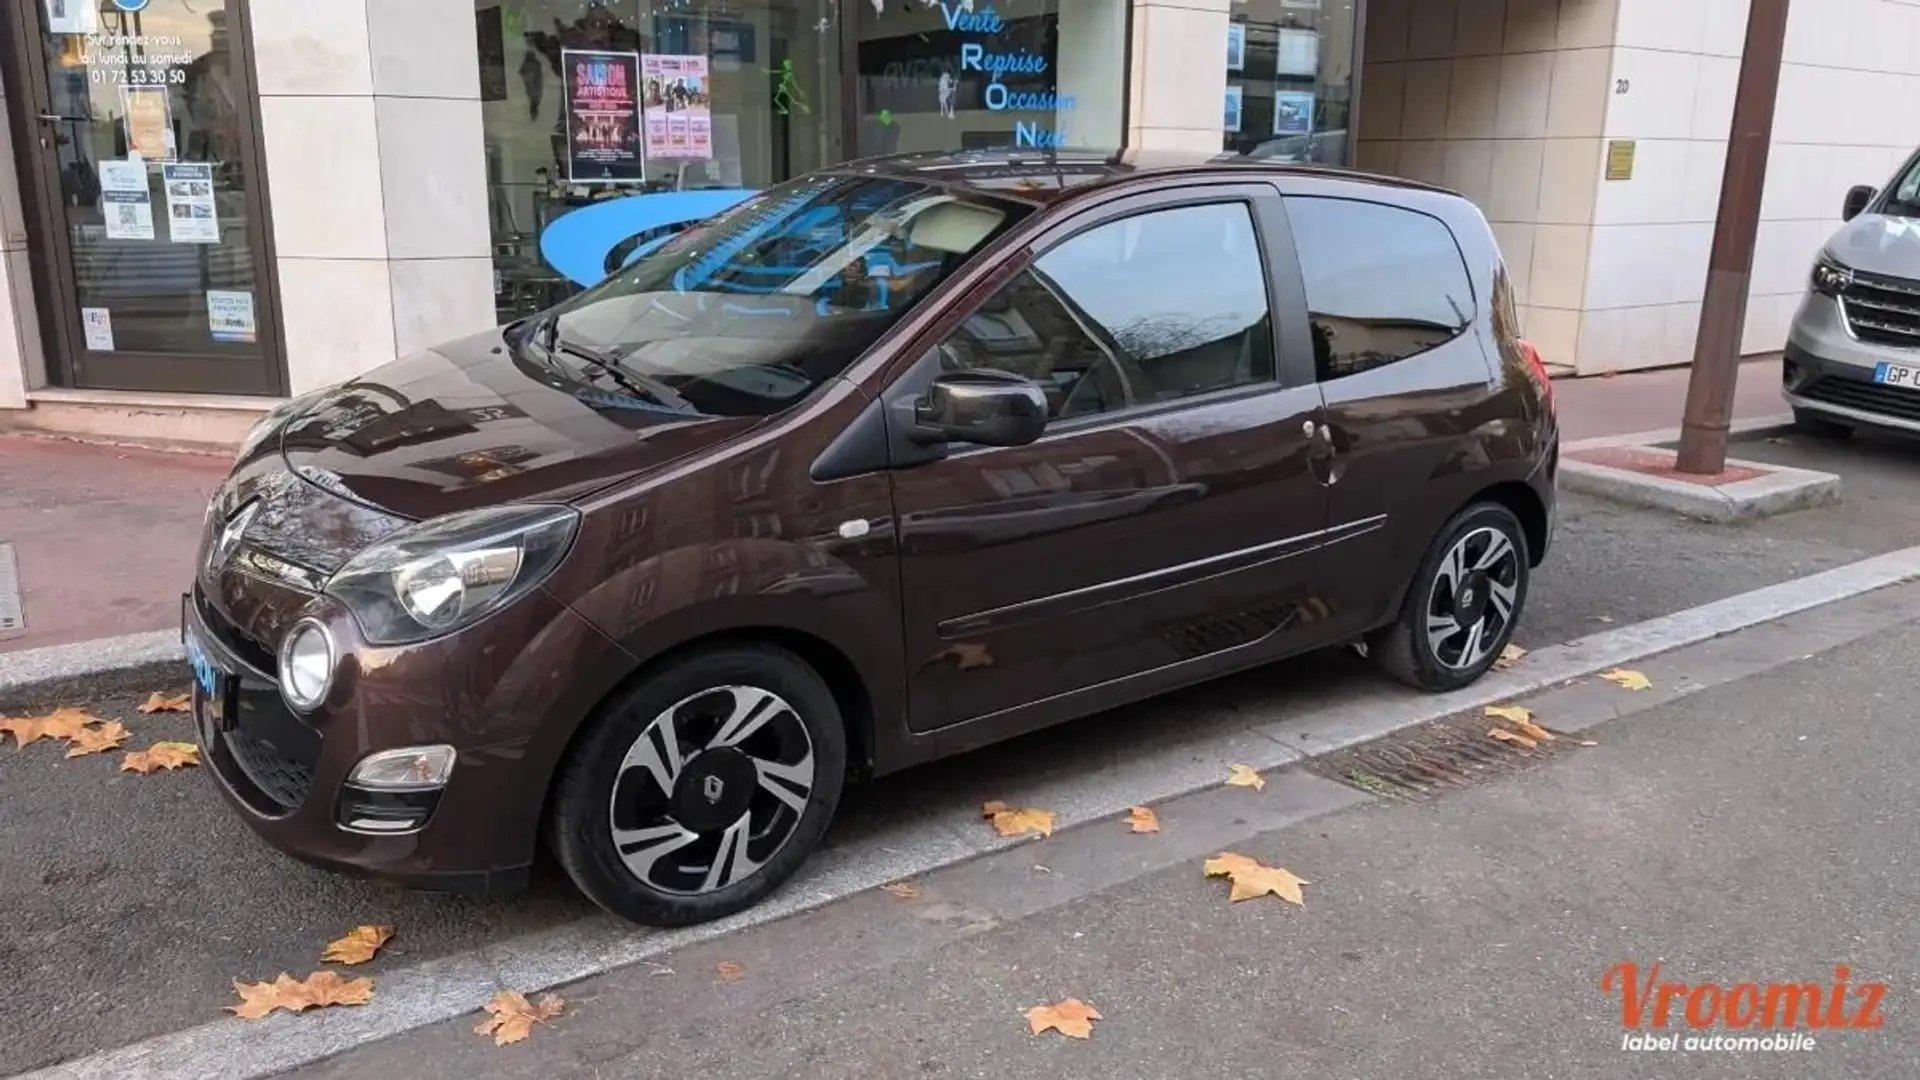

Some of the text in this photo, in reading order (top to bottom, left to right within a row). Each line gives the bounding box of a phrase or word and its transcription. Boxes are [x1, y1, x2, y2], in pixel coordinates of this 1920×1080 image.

[940, 2, 1004, 33] Vente
[99, 49, 129, 65] lundi
[131, 53, 147, 65] au
[149, 49, 193, 65] samedi
[961, 42, 1048, 81] Reprise
[91, 69, 186, 84] 01 72 53 30 50
[1615, 78, 1629, 94] 20
